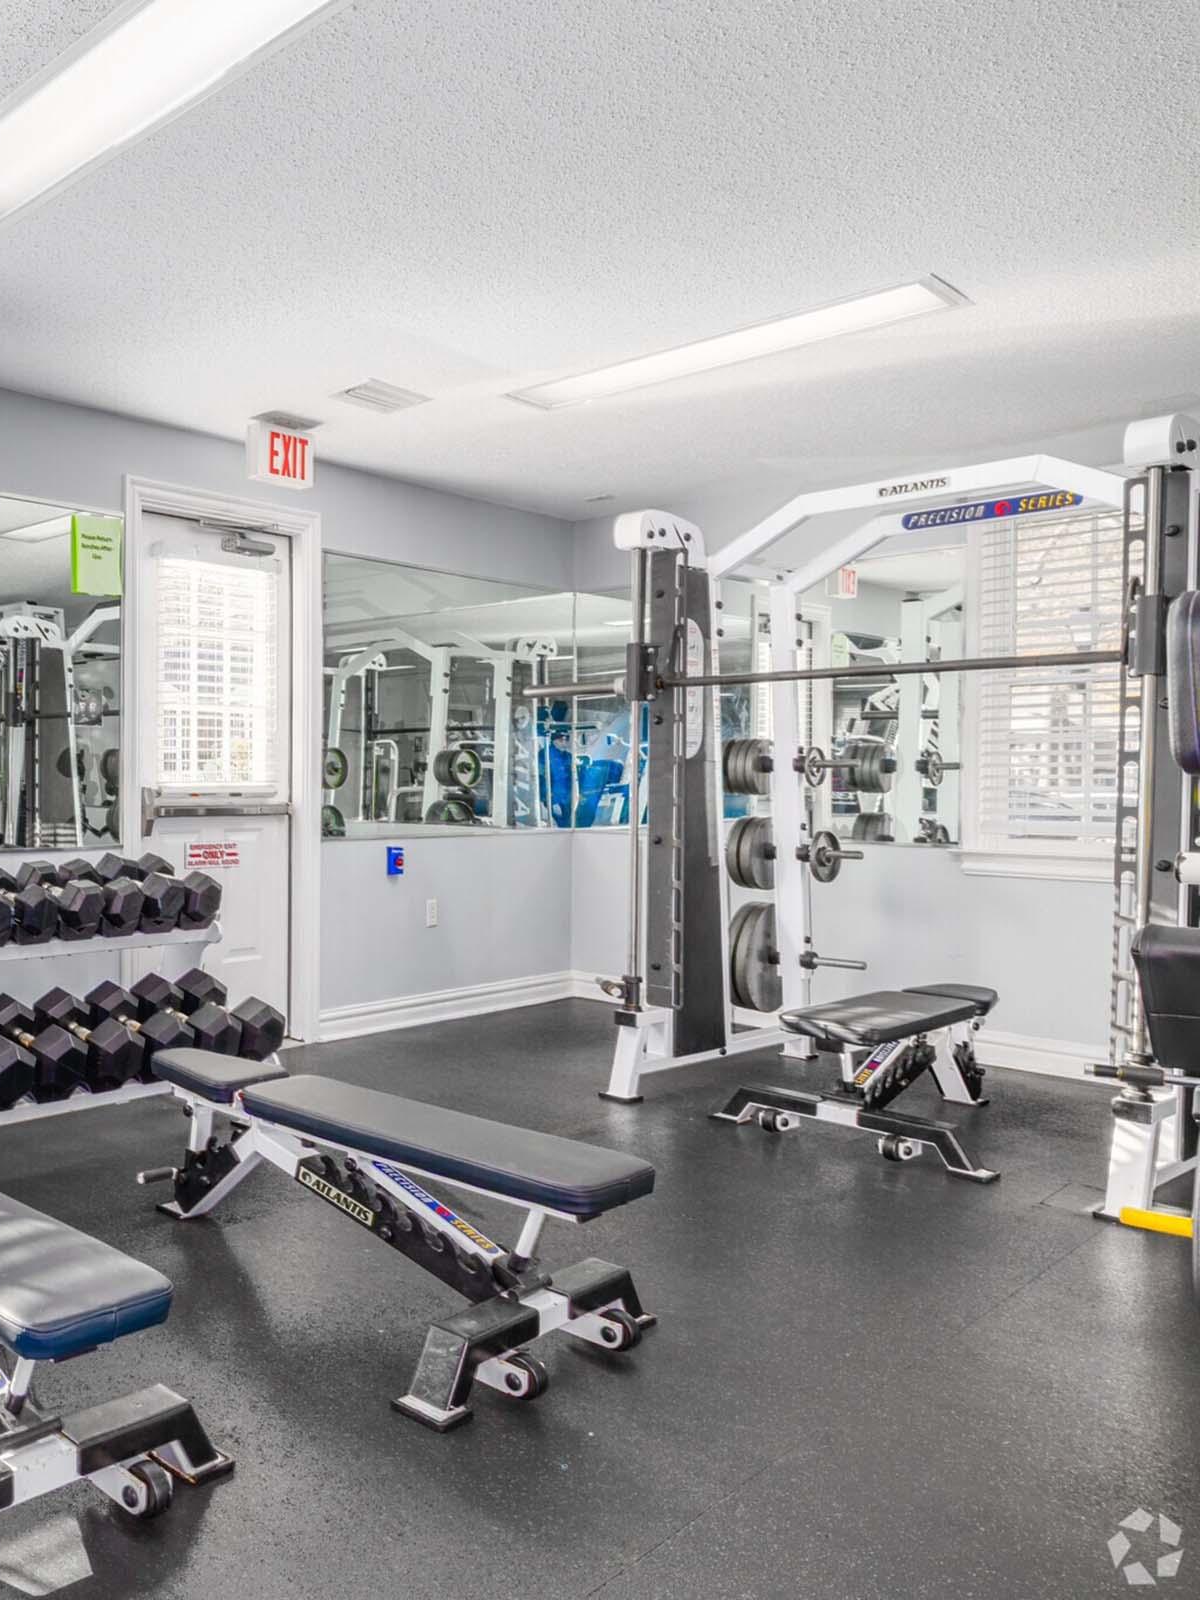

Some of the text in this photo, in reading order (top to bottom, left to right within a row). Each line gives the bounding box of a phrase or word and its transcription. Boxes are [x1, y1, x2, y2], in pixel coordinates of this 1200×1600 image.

[270, 431, 308, 481] EXIT
[890, 477, 946, 496] ATLANTIS
[908, 491, 1074, 528] PRECISION SERIES
[202, 850, 225, 860] ONLY
[312, 1177, 372, 1222] ATLANTIS
[376, 1162, 494, 1250] PRECISION SERIES
